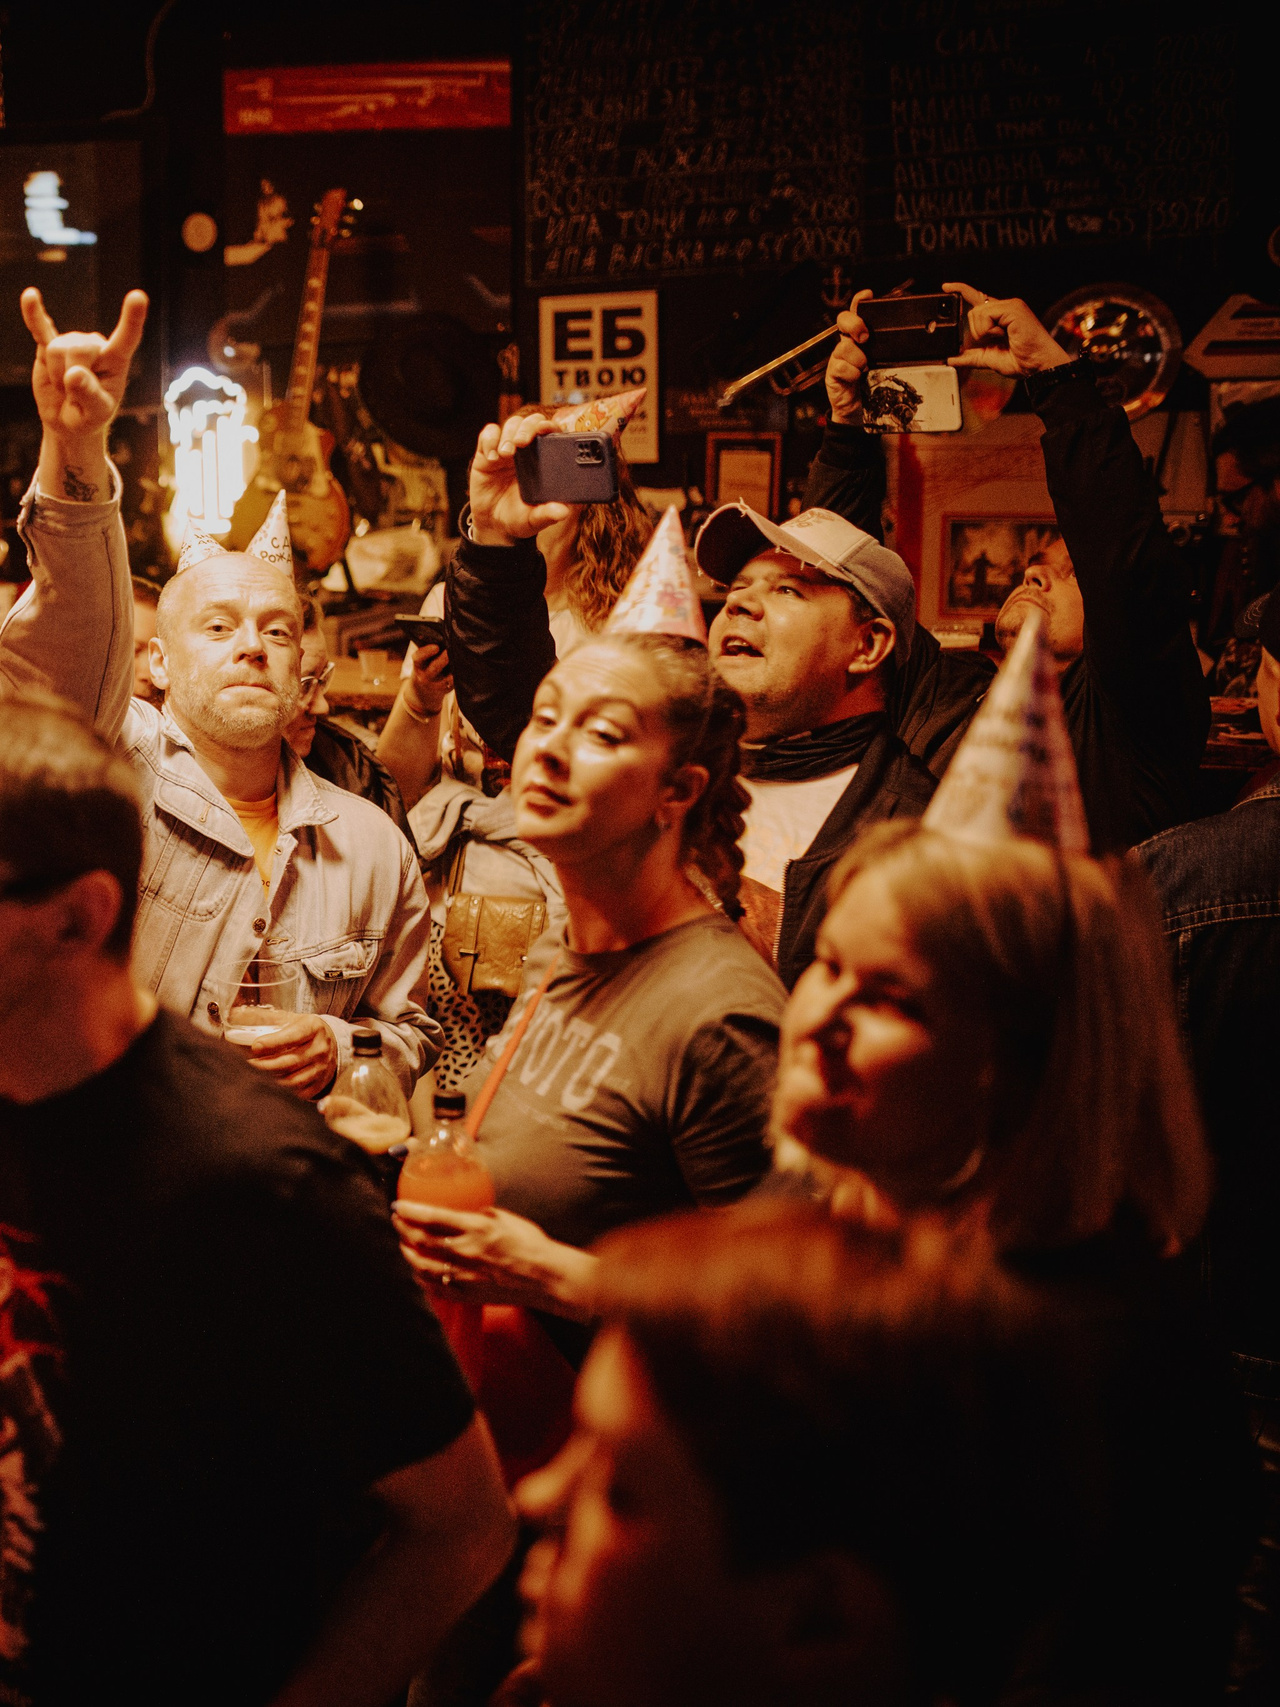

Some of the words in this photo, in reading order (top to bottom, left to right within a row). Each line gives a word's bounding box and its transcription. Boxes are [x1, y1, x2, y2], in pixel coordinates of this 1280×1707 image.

[891, 92, 992, 125] МАЛИНА
[893, 121, 980, 156] ГРУША
[894, 149, 1045, 189] АНТОНОВКА
[544, 211, 603, 247] ИПА
[902, 208, 1058, 255] ТОМАТНЫЙ
[554, 307, 646, 361] ЕБ
[556, 367, 647, 387] ТВОЮ
